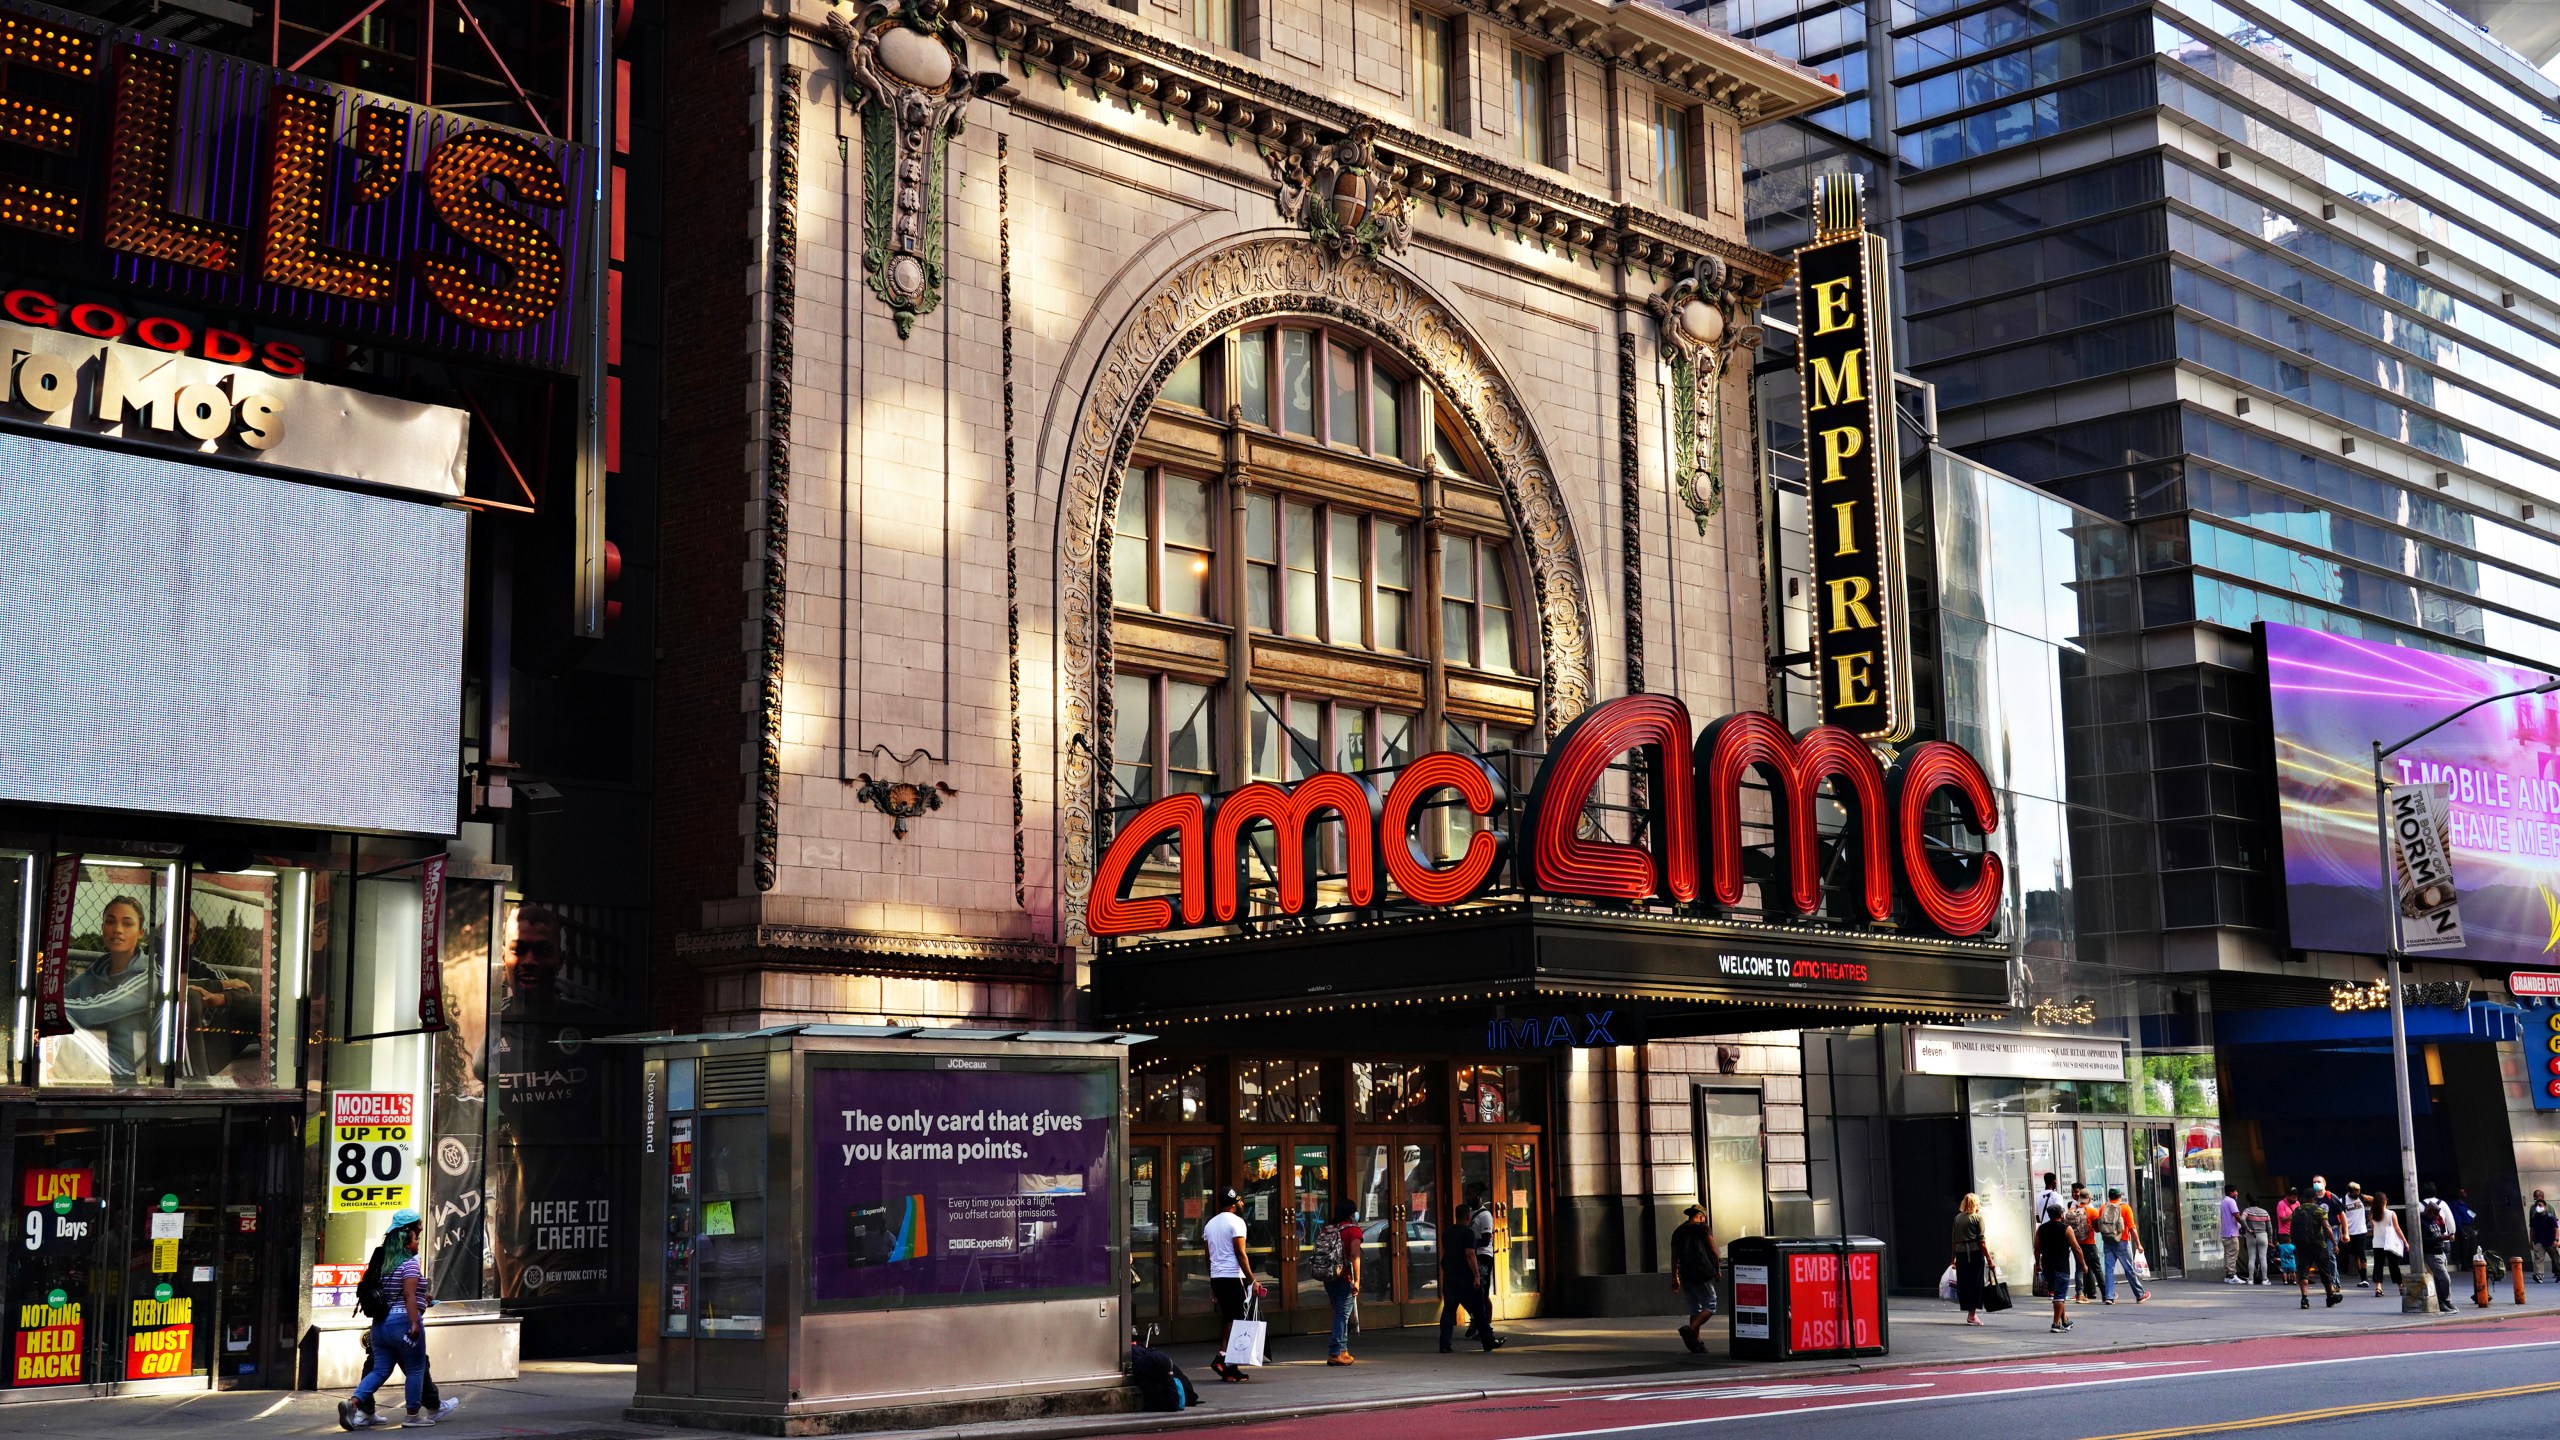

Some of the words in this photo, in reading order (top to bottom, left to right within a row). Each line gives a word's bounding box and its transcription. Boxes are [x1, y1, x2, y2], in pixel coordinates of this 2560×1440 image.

[4, 289, 306, 375] GOODS
[1809, 276, 1877, 710] EMPIRE
[2413, 790, 2427, 816] THE
[2419, 817, 2438, 856] BOOK
[2450, 810, 2510, 852] HAVE
[2432, 857, 2446, 876] OF
[49, 858, 75, 995] MODELL'S
[425, 859, 443, 992] MODELL'S
[1718, 954, 1773, 976] WELCOME
[1776, 959, 1790, 978] TO
[1821, 962, 1868, 982] THEATRES
[2513, 976, 2546, 992] BRANDED
[1487, 1011, 1616, 1050] IMAX
[1922, 1045, 1943, 1057] eleven
[948, 1059, 987, 1069] JCDecaux
[499, 1068, 588, 1088] ETIHAD
[338, 1095, 412, 1115] MODELL'S
[512, 1089, 572, 1103] AIRWAYS
[337, 1115, 379, 1124] SPORTING
[382, 1115, 411, 1124] GOODS
[646, 1073, 655, 1153] Newsstand
[842, 1109, 883, 1131] The
[887, 1110, 934, 1136] only
[937, 1109, 984, 1132] card
[988, 1110, 1029, 1132] that
[1032, 1109, 1082, 1136] gives
[341, 1127, 370, 1141] UP
[378, 1127, 406, 1140] TO
[842, 1143, 882, 1166] you
[887, 1138, 954, 1161] karma
[958, 1137, 1028, 1164] points.
[37, 1174, 80, 1202] LAST
[340, 1187, 403, 1201] OFF
[530, 1200, 579, 1225] HERE
[586, 1200, 609, 1223] TO
[863, 1205, 887, 1217] Expensify
[949, 1198, 970, 1210] Every
[971, 1198, 989, 1208] time
[991, 1199, 1005, 1209] you
[1006, 1196, 1025, 1207] book
[1033, 1195, 1055, 1208] flight,
[949, 1211, 963, 1221] you
[965, 1209, 988, 1219] offset
[990, 1208, 1016, 1218] carbon
[1018, 1208, 1058, 1218] emissions.
[26, 1210, 43, 1250] 9
[56, 1217, 88, 1240] Days
[537, 1226, 608, 1250] CREATE
[971, 1237, 1013, 1250] Expensify
[546, 1272, 561, 1281] NEW
[564, 1271, 581, 1281] YORK
[582, 1270, 597, 1279] CITY
[599, 1269, 608, 1279] FC
[1822, 1291, 1843, 1308] THE
[21, 1303, 81, 1328] NOTHING
[133, 1297, 192, 1327] EVERYTHING
[27, 1330, 75, 1354] HELD
[134, 1330, 189, 1352] MUST
[18, 1354, 81, 1380] BACK!
[141, 1352, 182, 1375] GO!
